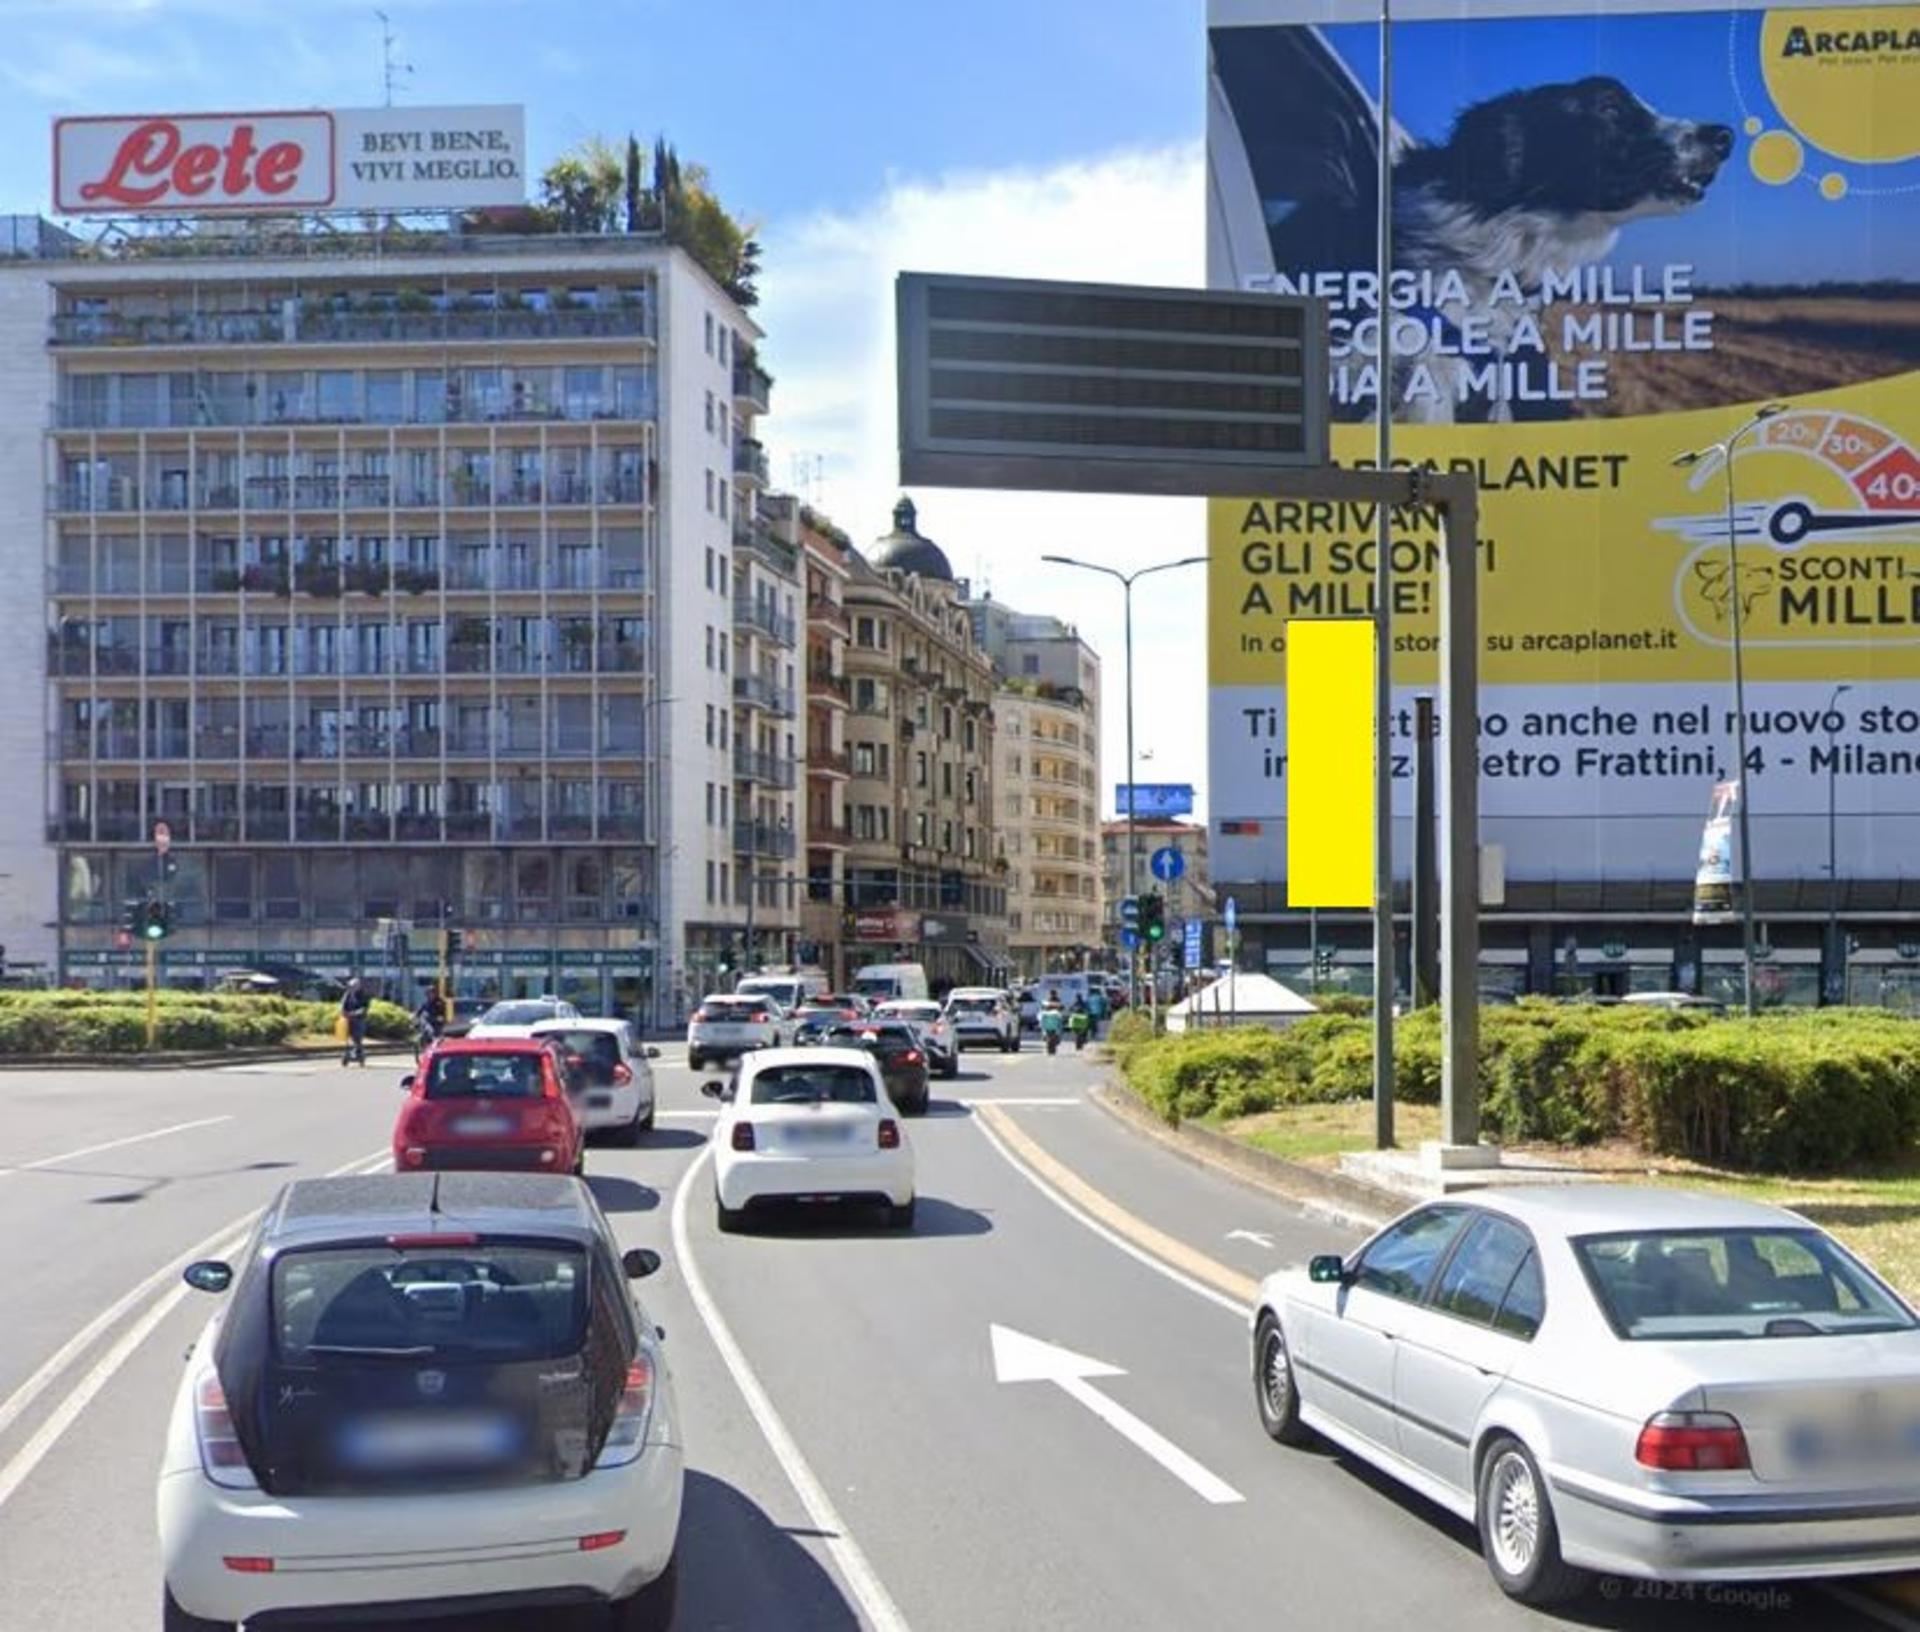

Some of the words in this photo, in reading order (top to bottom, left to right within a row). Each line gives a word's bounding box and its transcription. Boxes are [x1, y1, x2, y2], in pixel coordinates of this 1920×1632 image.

[362, 132, 422, 152] BEVI
[431, 130, 510, 153] BENE,
[80, 119, 304, 204] Lete
[352, 162, 403, 182] VIVI
[413, 160, 520, 180] MEGLIO.
[1488, 268, 1526, 304] A
[1543, 264, 1694, 304] MILLE
[1510, 314, 1546, 352] A
[1564, 311, 1714, 351] MILLE
[1404, 363, 1440, 403] A
[1458, 360, 1608, 401] MILLE
[1241, 541, 1310, 574] GLI
[1241, 583, 1272, 614] A
[1241, 634, 1263, 652] In
[1394, 634, 1442, 652] stor
[1486, 637, 1513, 651] su
[1521, 630, 1677, 653] arcaplanet.it
[1242, 708, 1276, 737] Ti
[1521, 706, 1637, 737] anche
[1653, 705, 1709, 735] nel
[1726, 710, 1845, 735] nuovo
[1576, 746, 1727, 781] Frattini,
[1743, 746, 1766, 775] 4
